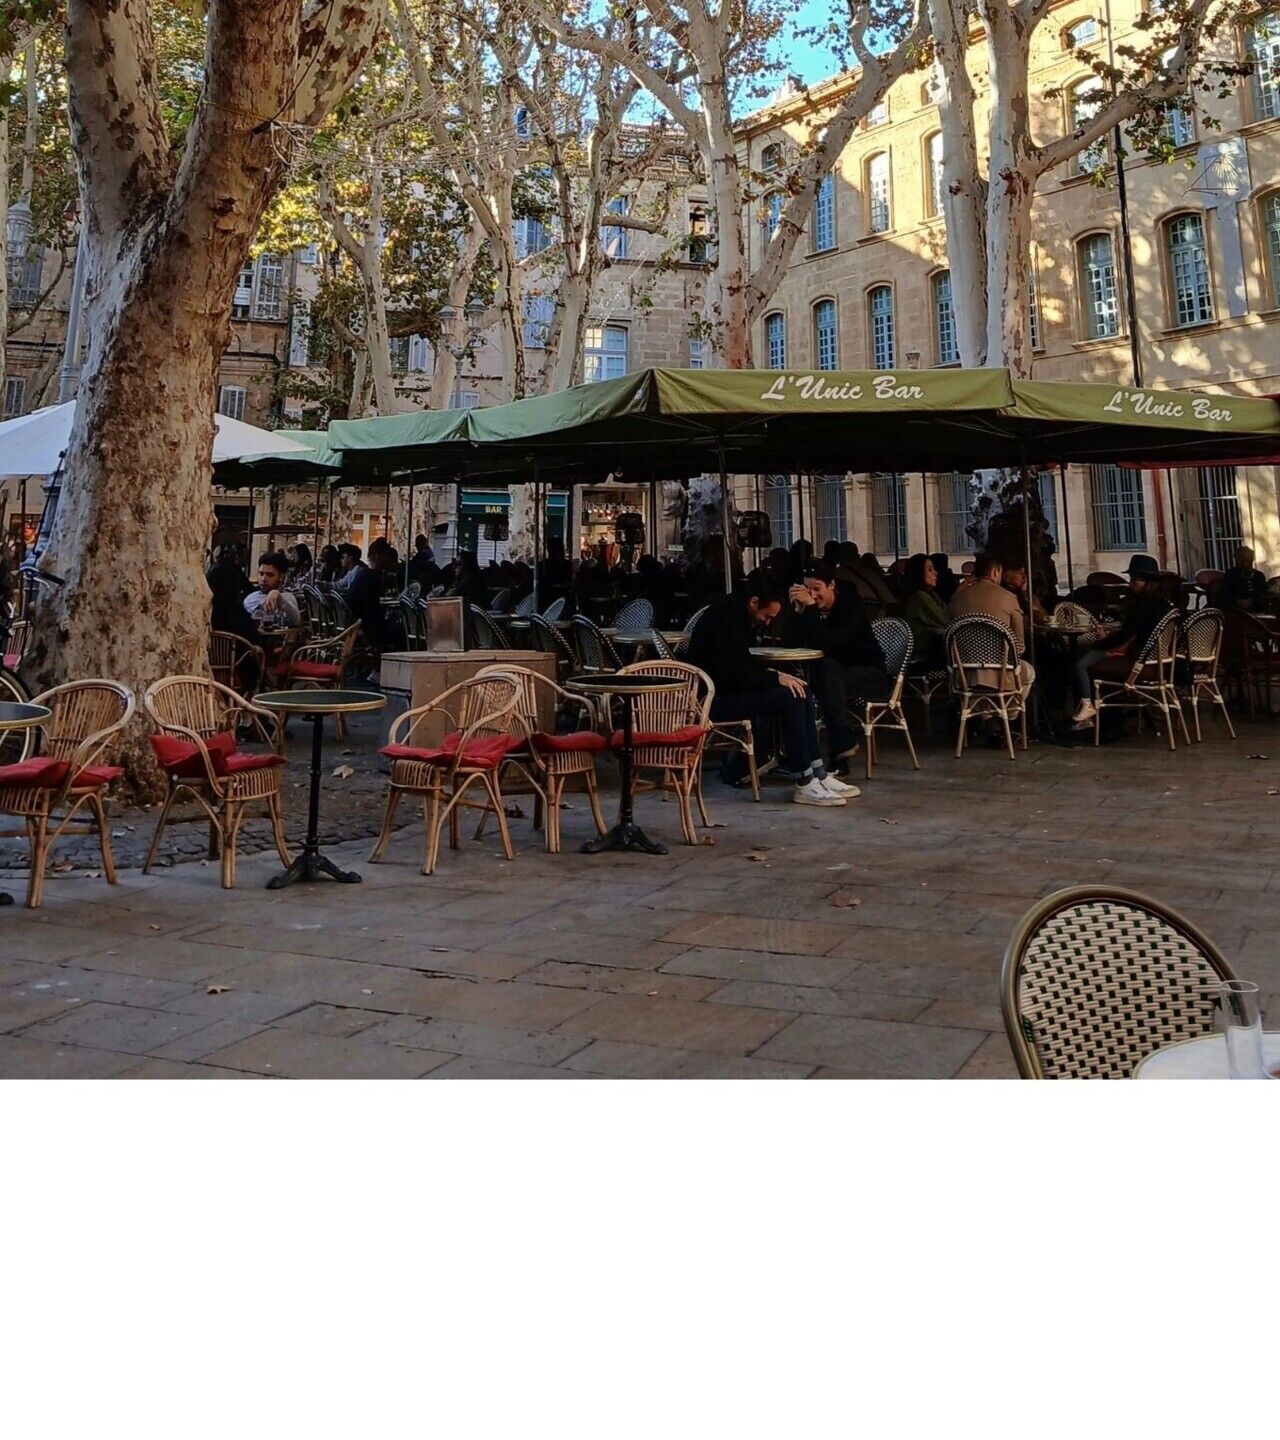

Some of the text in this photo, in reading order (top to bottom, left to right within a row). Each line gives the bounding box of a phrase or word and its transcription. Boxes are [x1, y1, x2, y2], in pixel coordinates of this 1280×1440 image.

[761, 375, 924, 400] L'Unic Bar
[1103, 391, 1233, 421] L'Unic Bar
[485, 505, 503, 513] BAR
